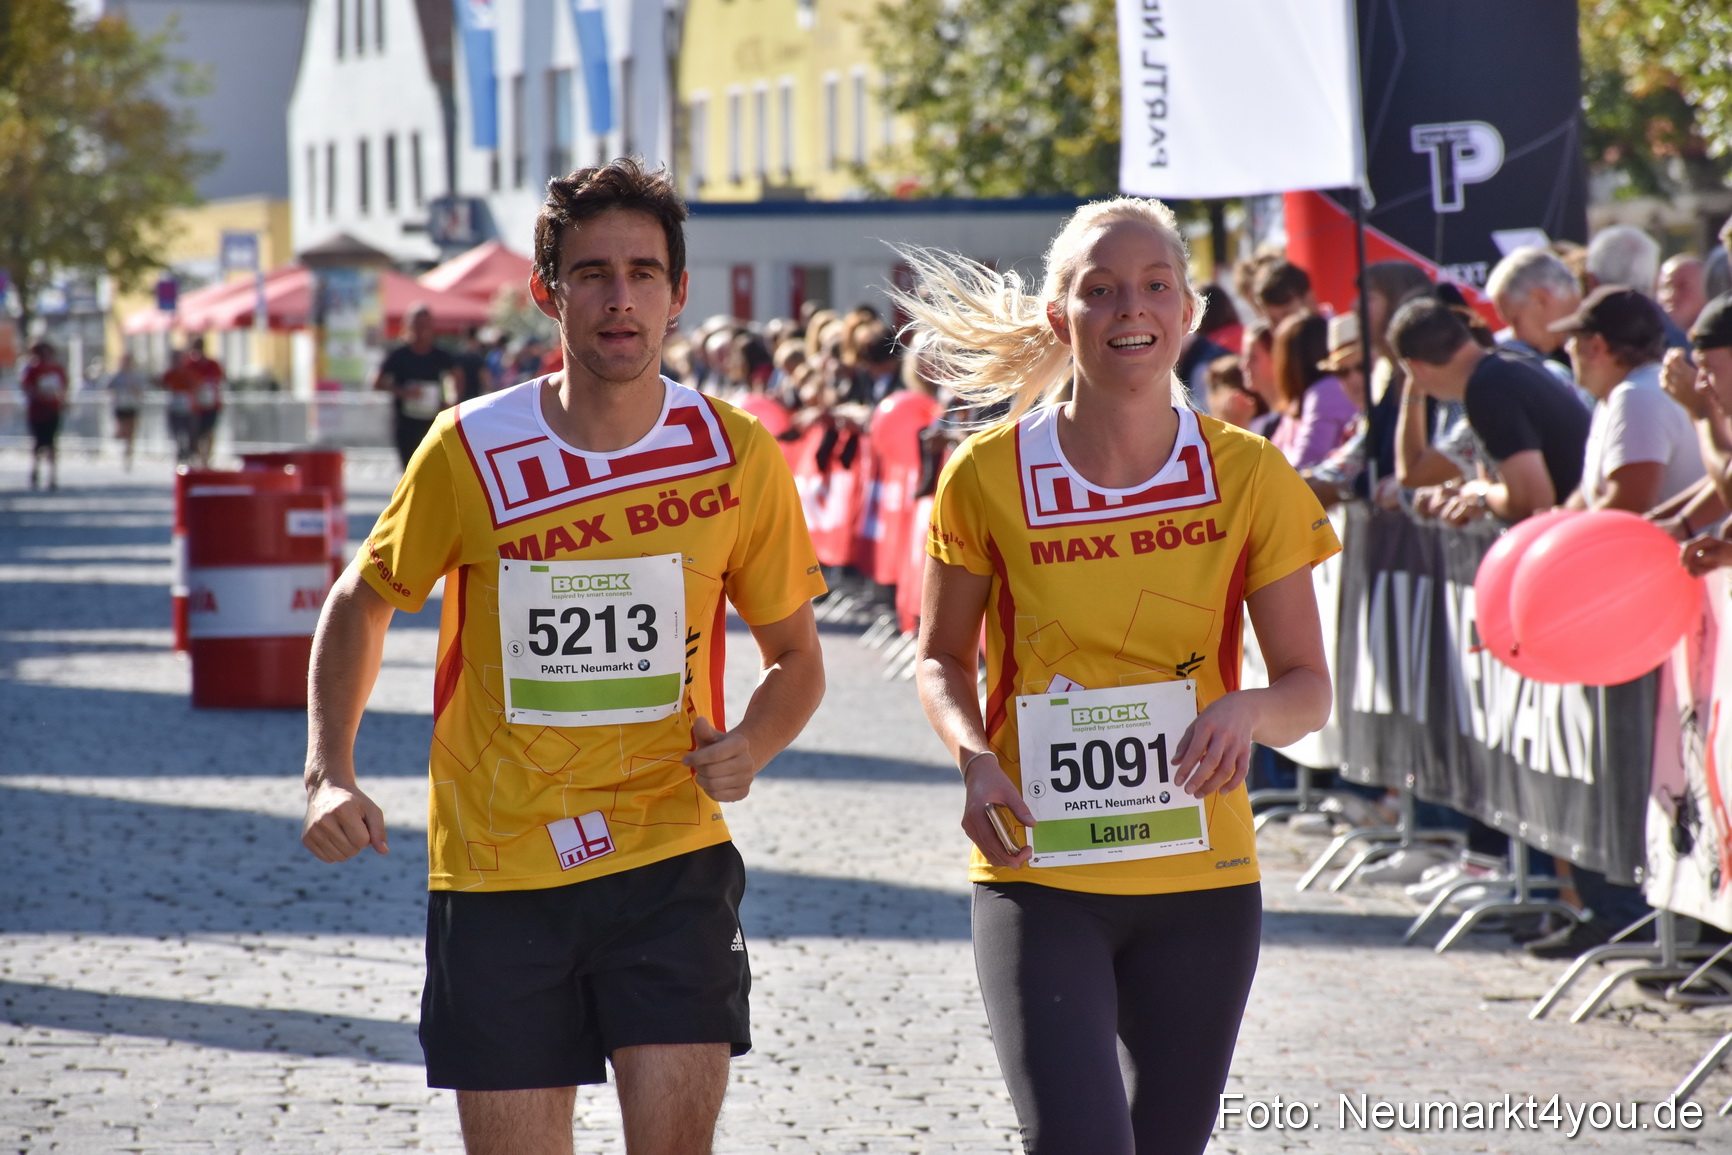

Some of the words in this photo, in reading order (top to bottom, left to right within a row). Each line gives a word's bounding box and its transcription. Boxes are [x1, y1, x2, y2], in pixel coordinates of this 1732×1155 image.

[498, 513, 613, 561] MAX
[625, 482, 740, 536] BÖGL
[1029, 534, 1120, 565] MAX
[1130, 518, 1227, 555] BÖGL
[551, 573, 631, 593] BOCK
[551, 592, 576, 600] inspired
[528, 603, 658, 657] 5213
[541, 664, 578, 674] PARTL
[581, 662, 634, 673] Neumarkt
[1071, 702, 1150, 726] BOCK
[1125, 721, 1151, 729] concepts
[1050, 733, 1169, 793] 5091
[1064, 800, 1103, 811] PARTL
[1105, 795, 1156, 808] Neumarkt
[1090, 822, 1150, 844] Laura
